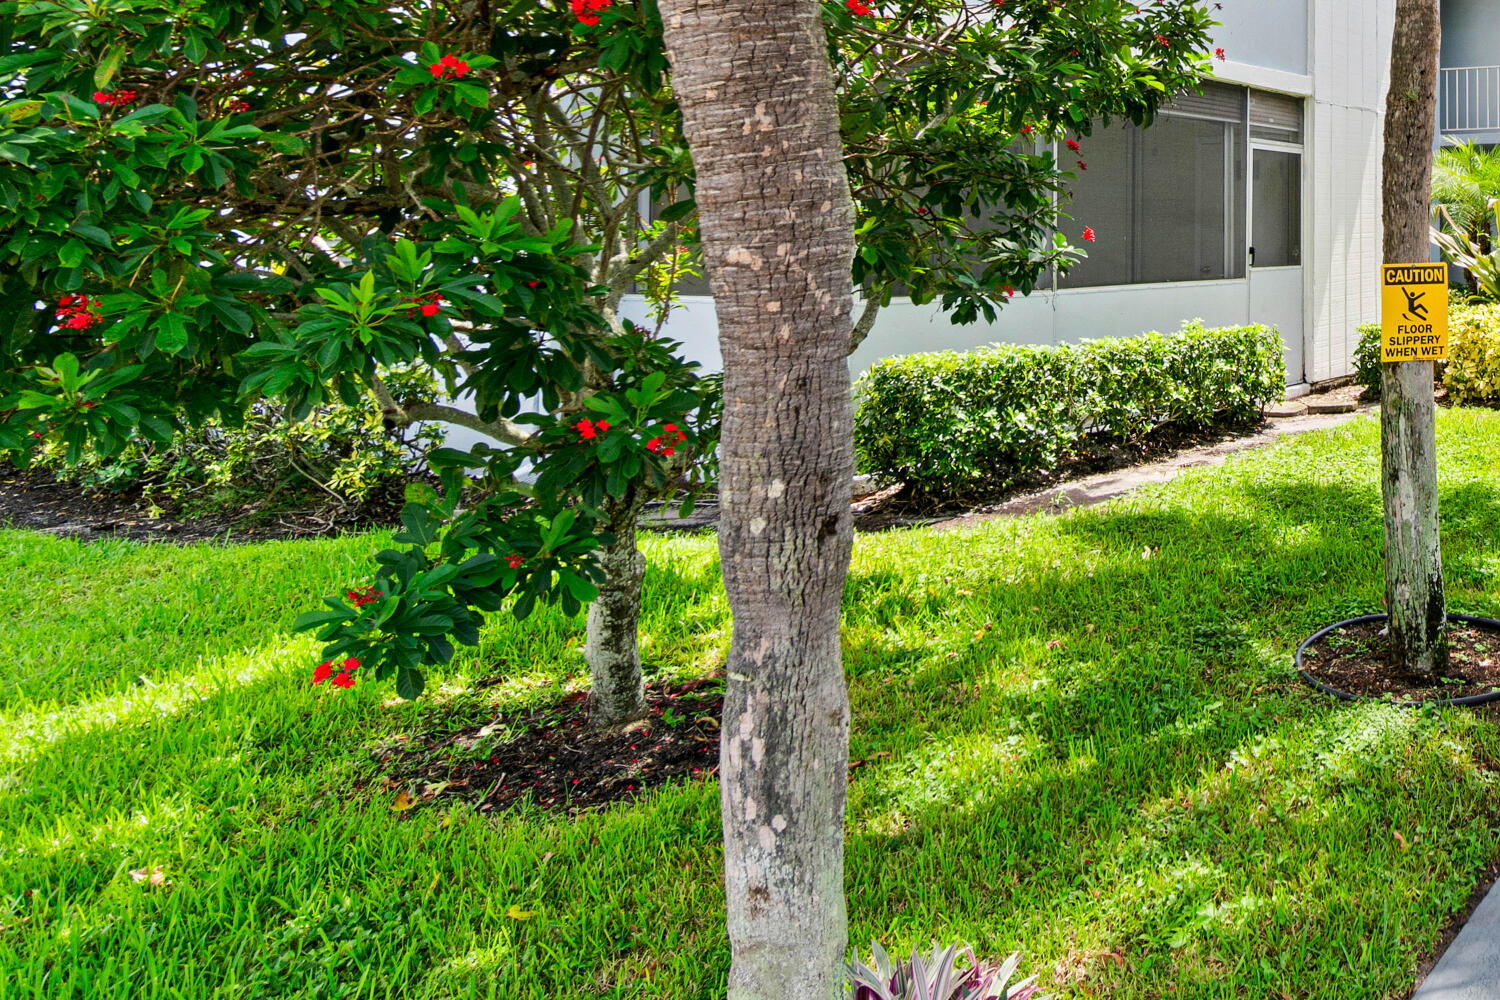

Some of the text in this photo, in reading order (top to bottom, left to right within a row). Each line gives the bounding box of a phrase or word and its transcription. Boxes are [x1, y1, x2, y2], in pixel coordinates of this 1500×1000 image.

[1386, 269, 1442, 282] CAUTION
[1397, 324, 1432, 334] FLOOR
[1389, 335, 1440, 346] SLIPPERY
[1386, 346, 1444, 357] WHEN WET
